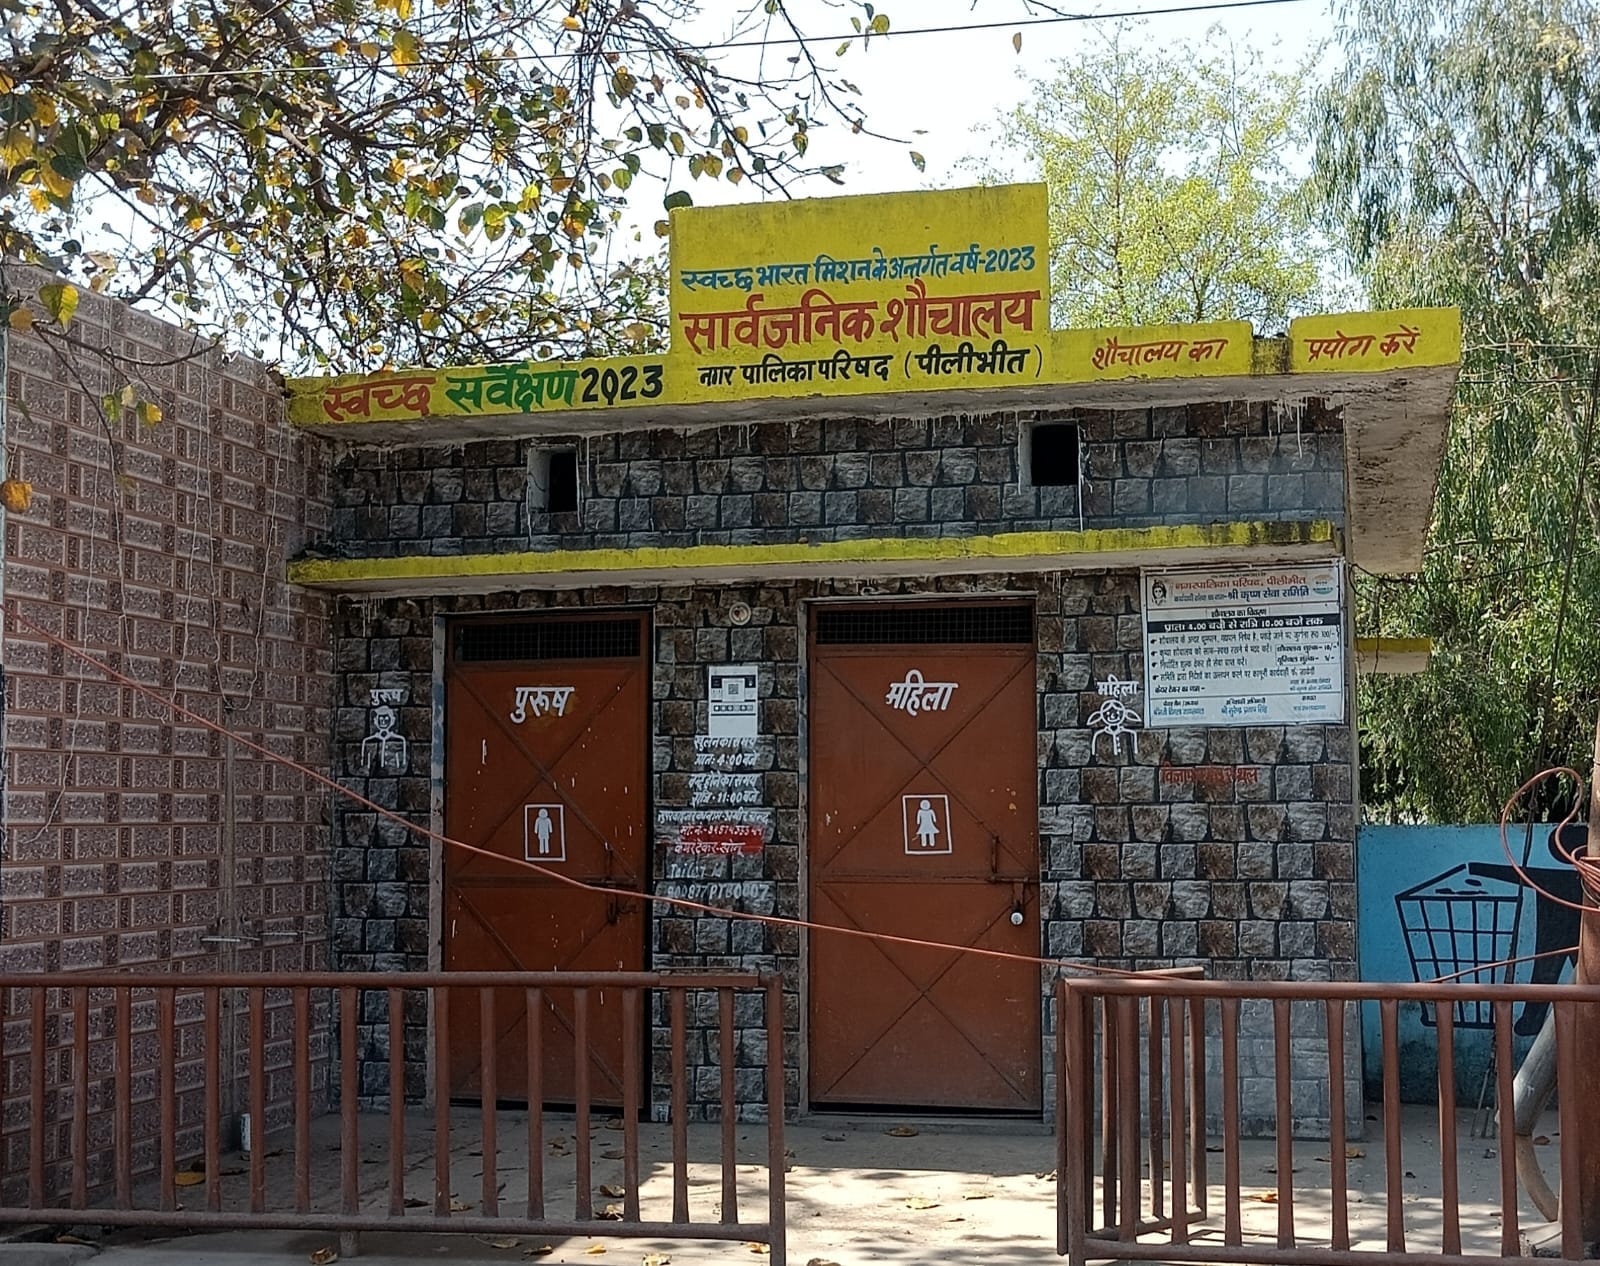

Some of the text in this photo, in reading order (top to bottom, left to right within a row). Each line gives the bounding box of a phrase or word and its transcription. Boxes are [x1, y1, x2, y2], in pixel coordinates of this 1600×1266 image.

[680, 267, 753, 293] स्वच्छ
[756, 263, 812, 287] भारत
[813, 254, 871, 285] मिशन
[679, 278, 1041, 354] सार्वजनिक शौचालय
[740, 353, 818, 385] पालिका
[818, 349, 894, 381] परिषद
[1092, 324, 1421, 370] शौचालय का प्रयोग करें
[323, 376, 437, 421] स्वच्छ
[581, 364, 663, 406] 2023
[885, 669, 959, 716] महिला
[1097, 674, 1139, 697] महिला
